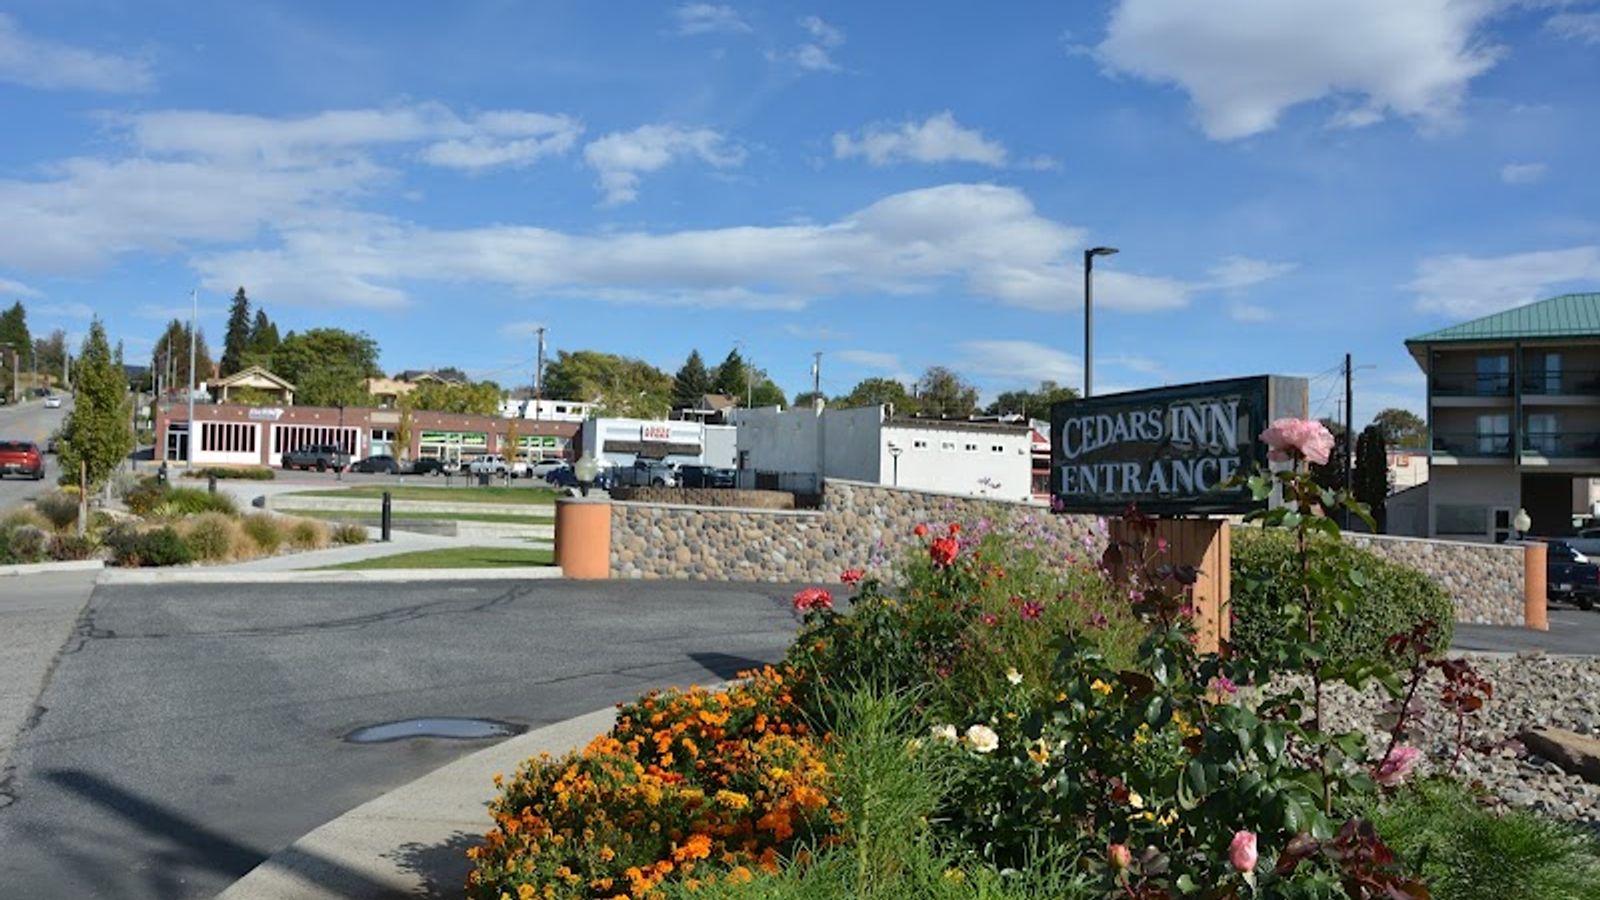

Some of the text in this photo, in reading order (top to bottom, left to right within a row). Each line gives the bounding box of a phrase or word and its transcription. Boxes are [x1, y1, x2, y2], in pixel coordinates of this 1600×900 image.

[1062, 401, 1239, 459] CEDARS INN
[1061, 457, 1242, 495] ENTRANCE
